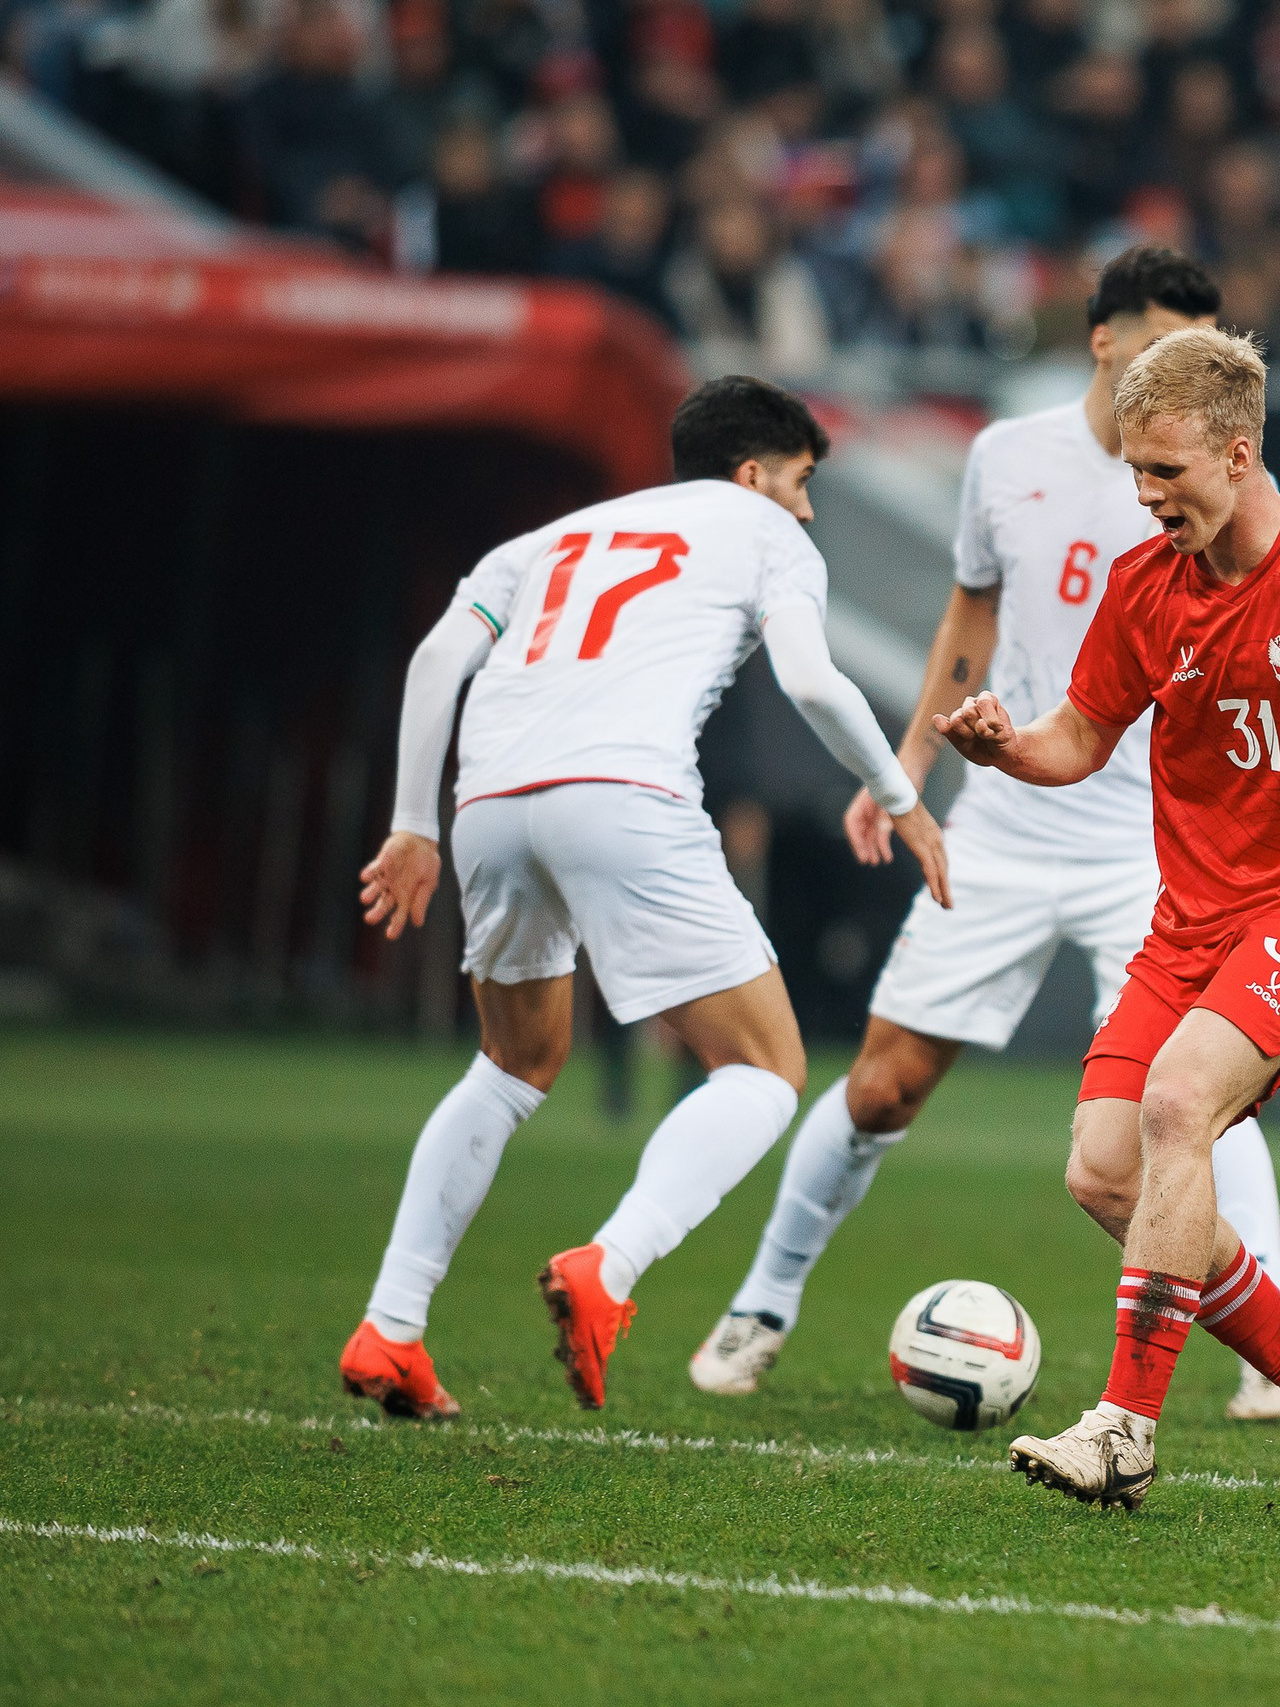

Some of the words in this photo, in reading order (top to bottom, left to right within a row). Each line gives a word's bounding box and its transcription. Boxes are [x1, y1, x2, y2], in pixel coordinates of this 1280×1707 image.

[525, 532, 690, 665] 17
[1058, 540, 1098, 605] 6
[1217, 698, 1280, 772] 31
